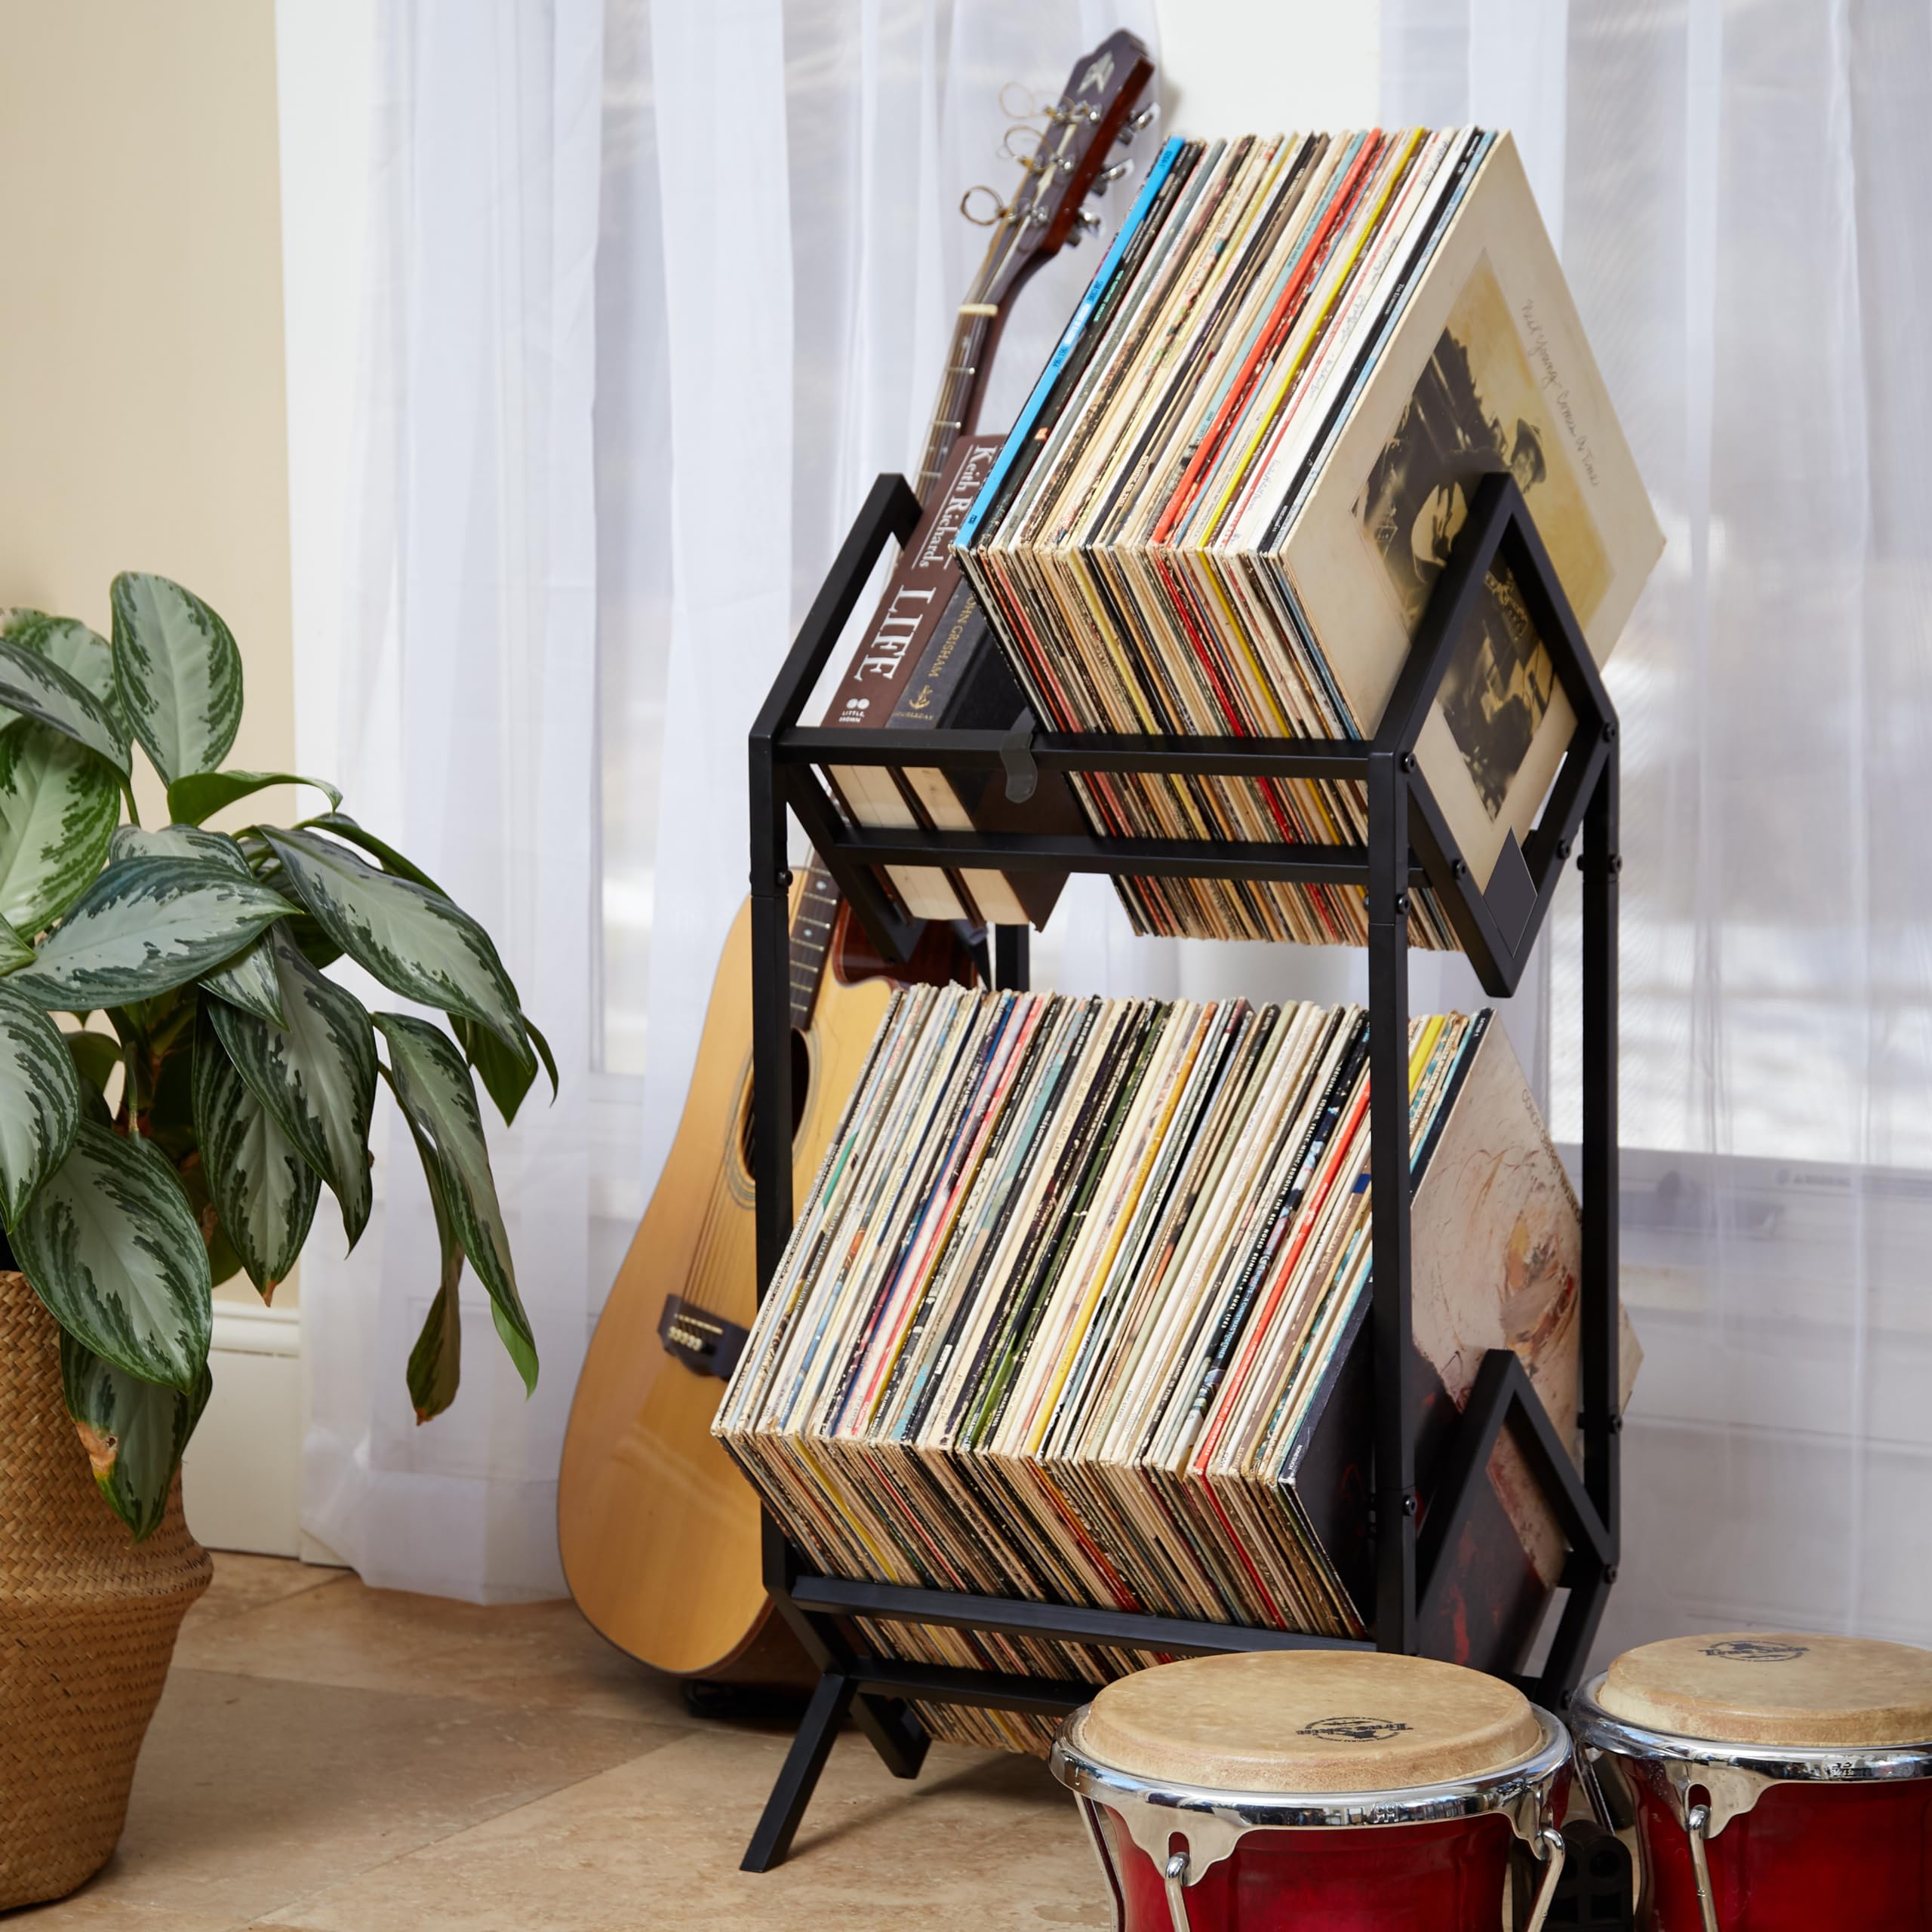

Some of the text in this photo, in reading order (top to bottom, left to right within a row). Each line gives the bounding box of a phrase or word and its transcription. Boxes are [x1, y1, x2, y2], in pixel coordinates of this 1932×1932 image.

[918, 445, 998, 569] Keith Richards
[853, 584, 937, 681] LIFE
[927, 626, 966, 678] GRISHAM
[1324, 1066, 1341, 1095] ORIGINAL
[1314, 1099, 1327, 1118] SOUND
[1241, 1116, 1255, 1138] JACKSON
[1273, 1198, 1283, 1209] THE
[1266, 1213, 1276, 1224] RED
[1256, 1229, 1269, 1249] NOSED
[1241, 1252, 1259, 1283] REINDEER
[1229, 1294, 1240, 1309] BURL
[1217, 1302, 1247, 1358] CHRISTMAS TOGETHER
[1220, 1313, 1232, 1328] IVES
[1172, 1356, 1185, 1378] ATLANTIC
[875, 1389, 891, 1417] COLUMBIA
[1087, 1389, 1112, 1439] COLUMBIA STEREO
[1114, 1401, 1128, 1422] STEREO
